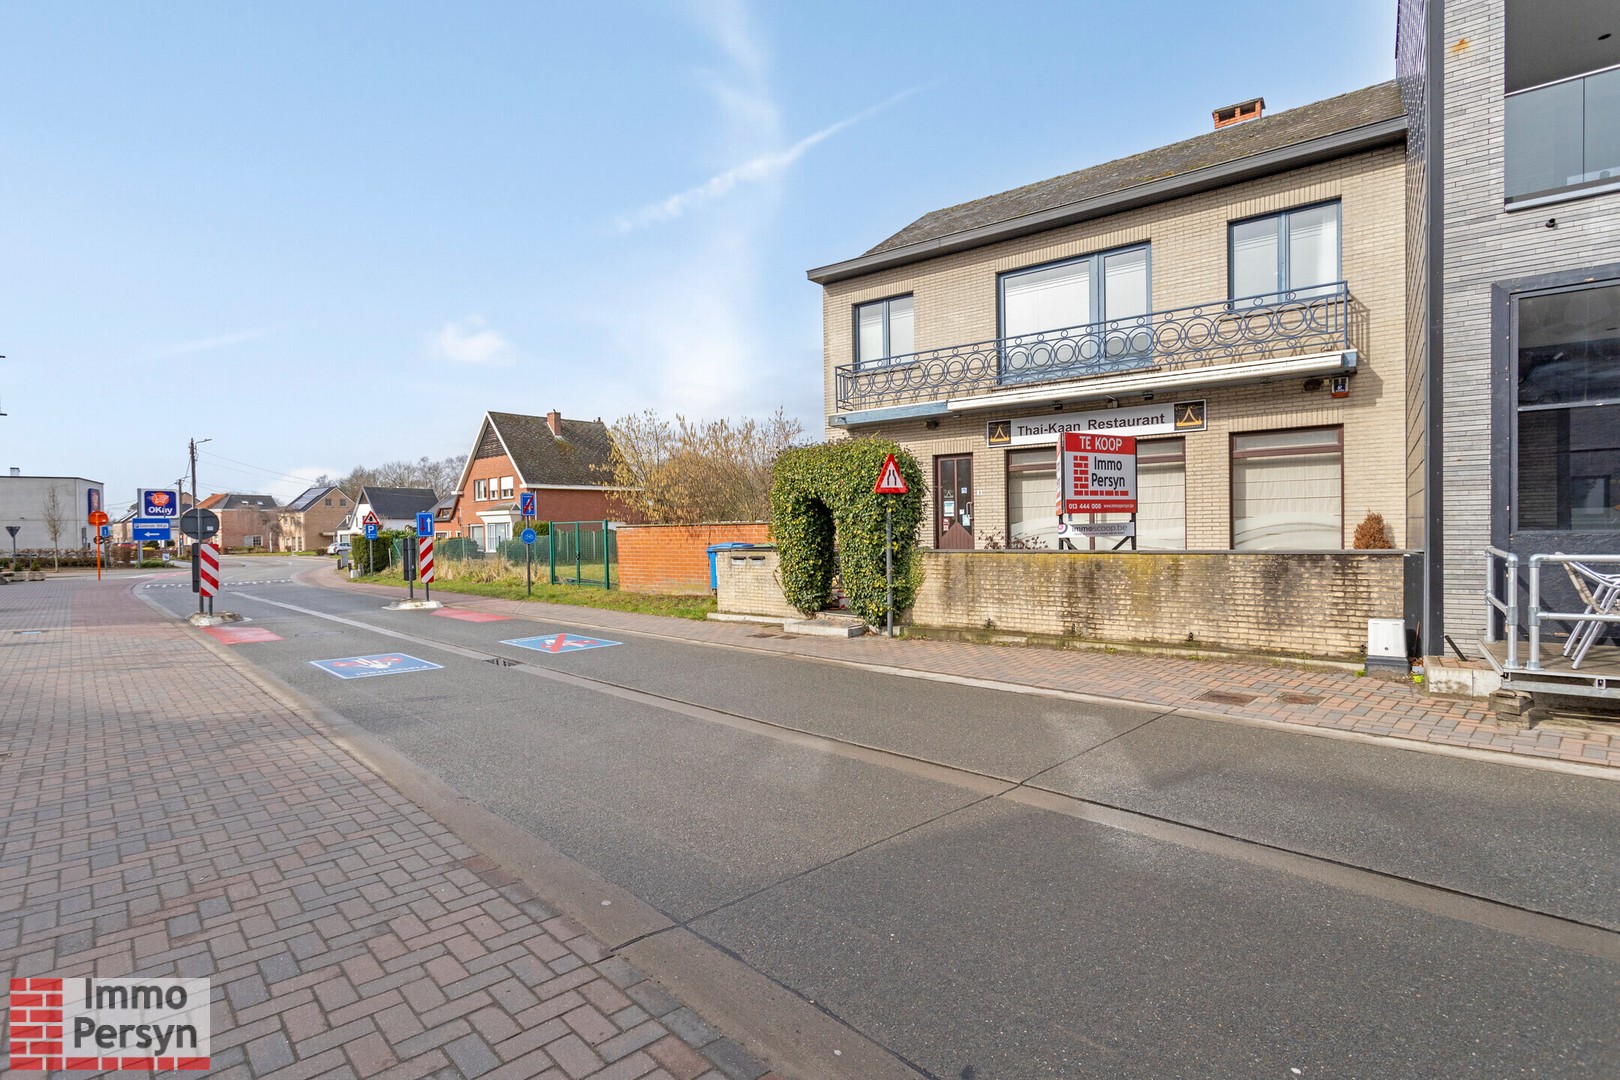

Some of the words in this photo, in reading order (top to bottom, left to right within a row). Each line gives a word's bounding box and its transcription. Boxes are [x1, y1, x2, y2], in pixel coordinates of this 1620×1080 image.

[1017, 422, 1081, 436] Thai-Kaan
[1088, 413, 1165, 430] Restaurant
[1079, 436, 1092, 450] TE
[1095, 437, 1123, 451] KOOP
[1094, 456, 1123, 471] Immo
[1091, 473, 1126, 490] Persyn
[148, 506, 173, 515] OKay
[1071, 525, 1128, 533] immoscoop.be
